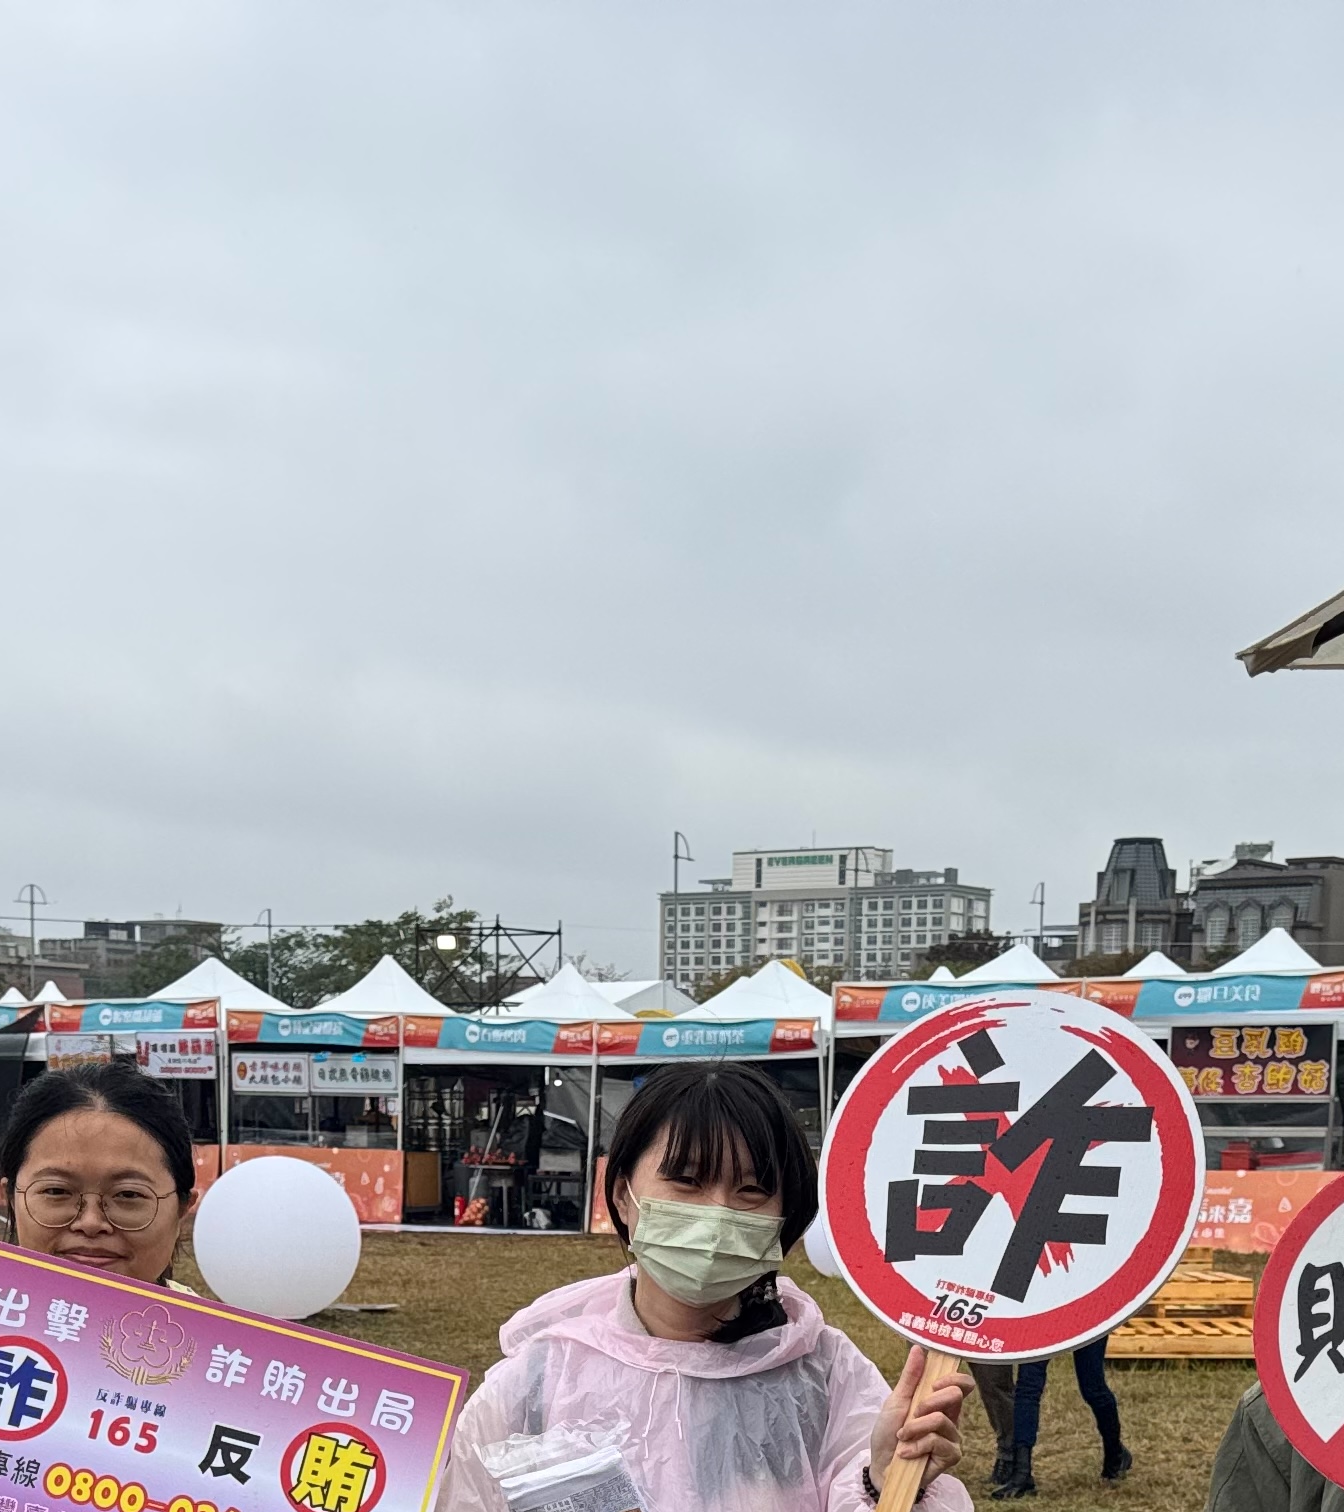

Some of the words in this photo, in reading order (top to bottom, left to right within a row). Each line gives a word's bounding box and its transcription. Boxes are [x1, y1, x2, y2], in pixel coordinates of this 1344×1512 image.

[1232, 1060, 1330, 1096] 杏鮑菇
[885, 1028, 1154, 1302] 詐
[899, 1312, 1004, 1352] 嘉義地檢署關心您
[932, 1293, 989, 1327] 165
[205, 1346, 417, 1435] 詐賄出局
[88, 1408, 158, 1454] 165
[200, 1425, 261, 1486] 反
